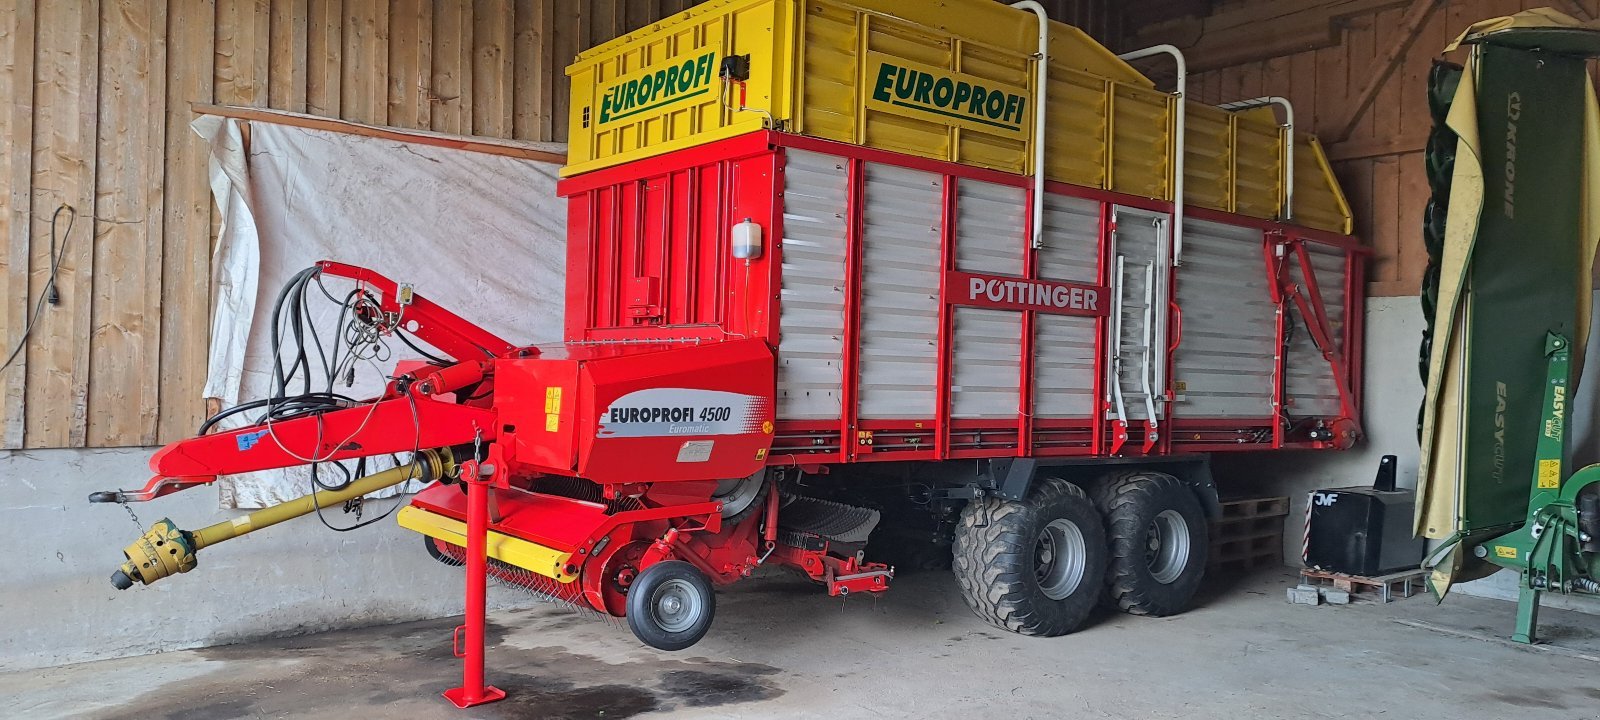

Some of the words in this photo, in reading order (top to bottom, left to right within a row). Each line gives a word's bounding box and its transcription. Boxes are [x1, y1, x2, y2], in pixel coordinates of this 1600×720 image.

[599, 51, 715, 124] EUROPROFI
[873, 63, 1026, 125] EUROPROFI
[1504, 121, 1516, 218] KRONE
[610, 407, 694, 423] EUROPROFI
[699, 406, 731, 422] 4500
[668, 423, 710, 434] Euromatic
